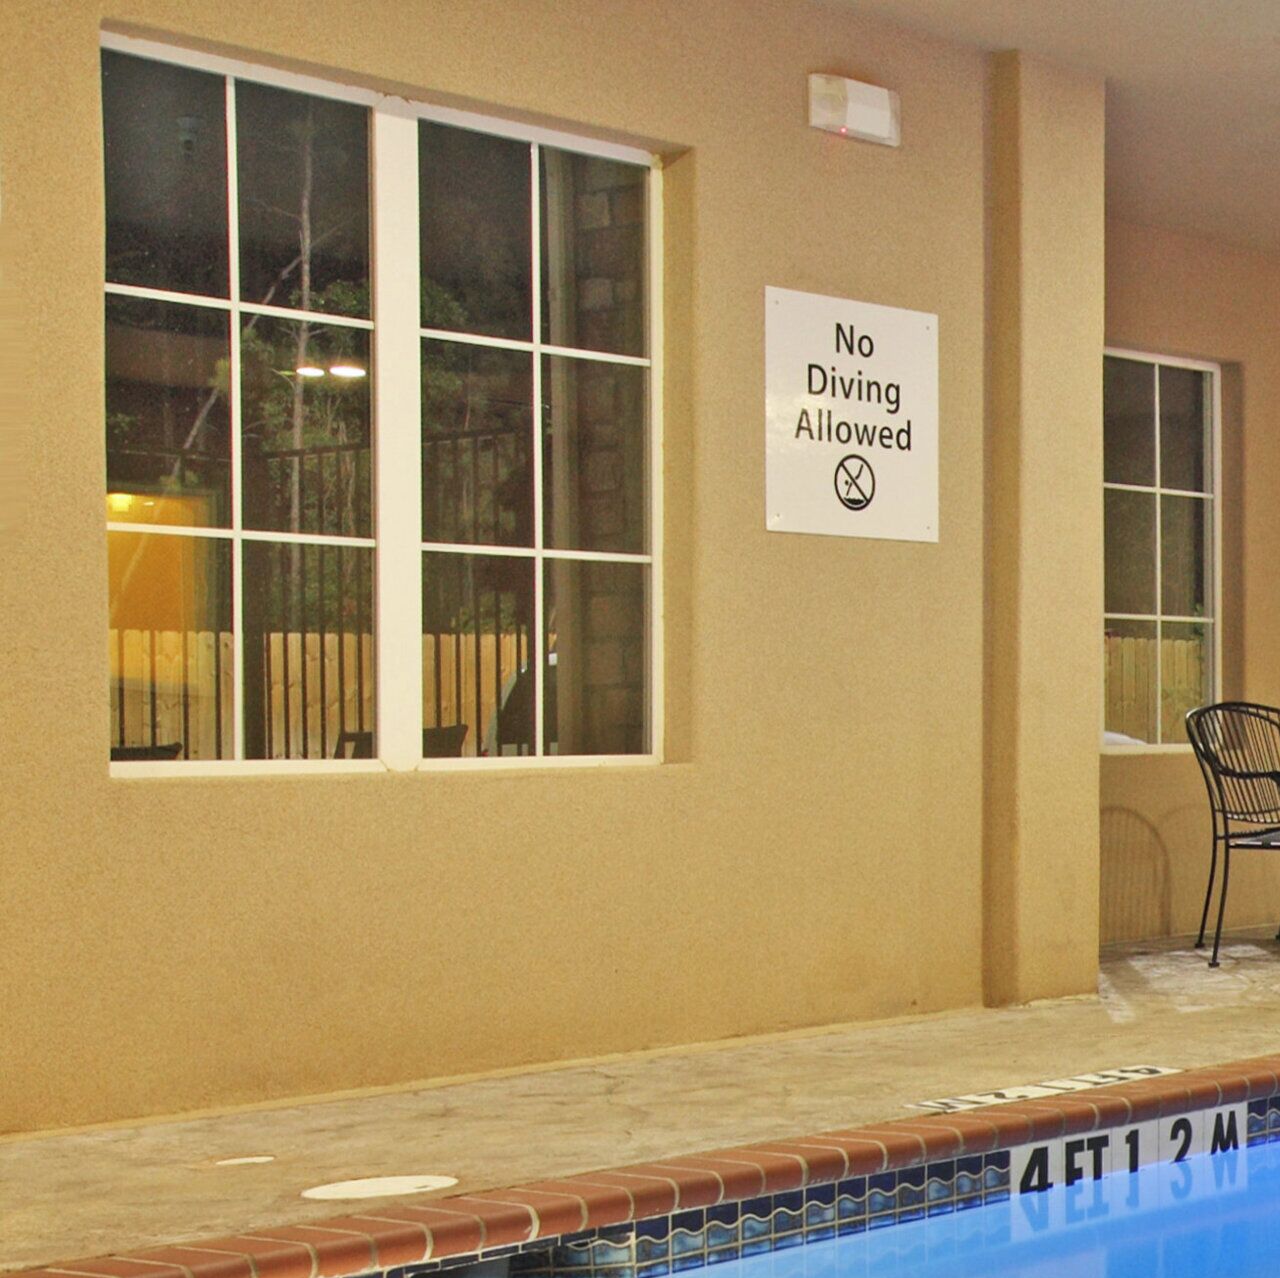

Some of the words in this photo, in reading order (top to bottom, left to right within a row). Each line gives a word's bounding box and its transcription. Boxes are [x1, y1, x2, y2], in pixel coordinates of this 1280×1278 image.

[835, 322, 874, 358] No
[807, 363, 901, 414] Diving
[794, 408, 912, 451] Allowed
[1020, 1146, 1053, 1194] 4
